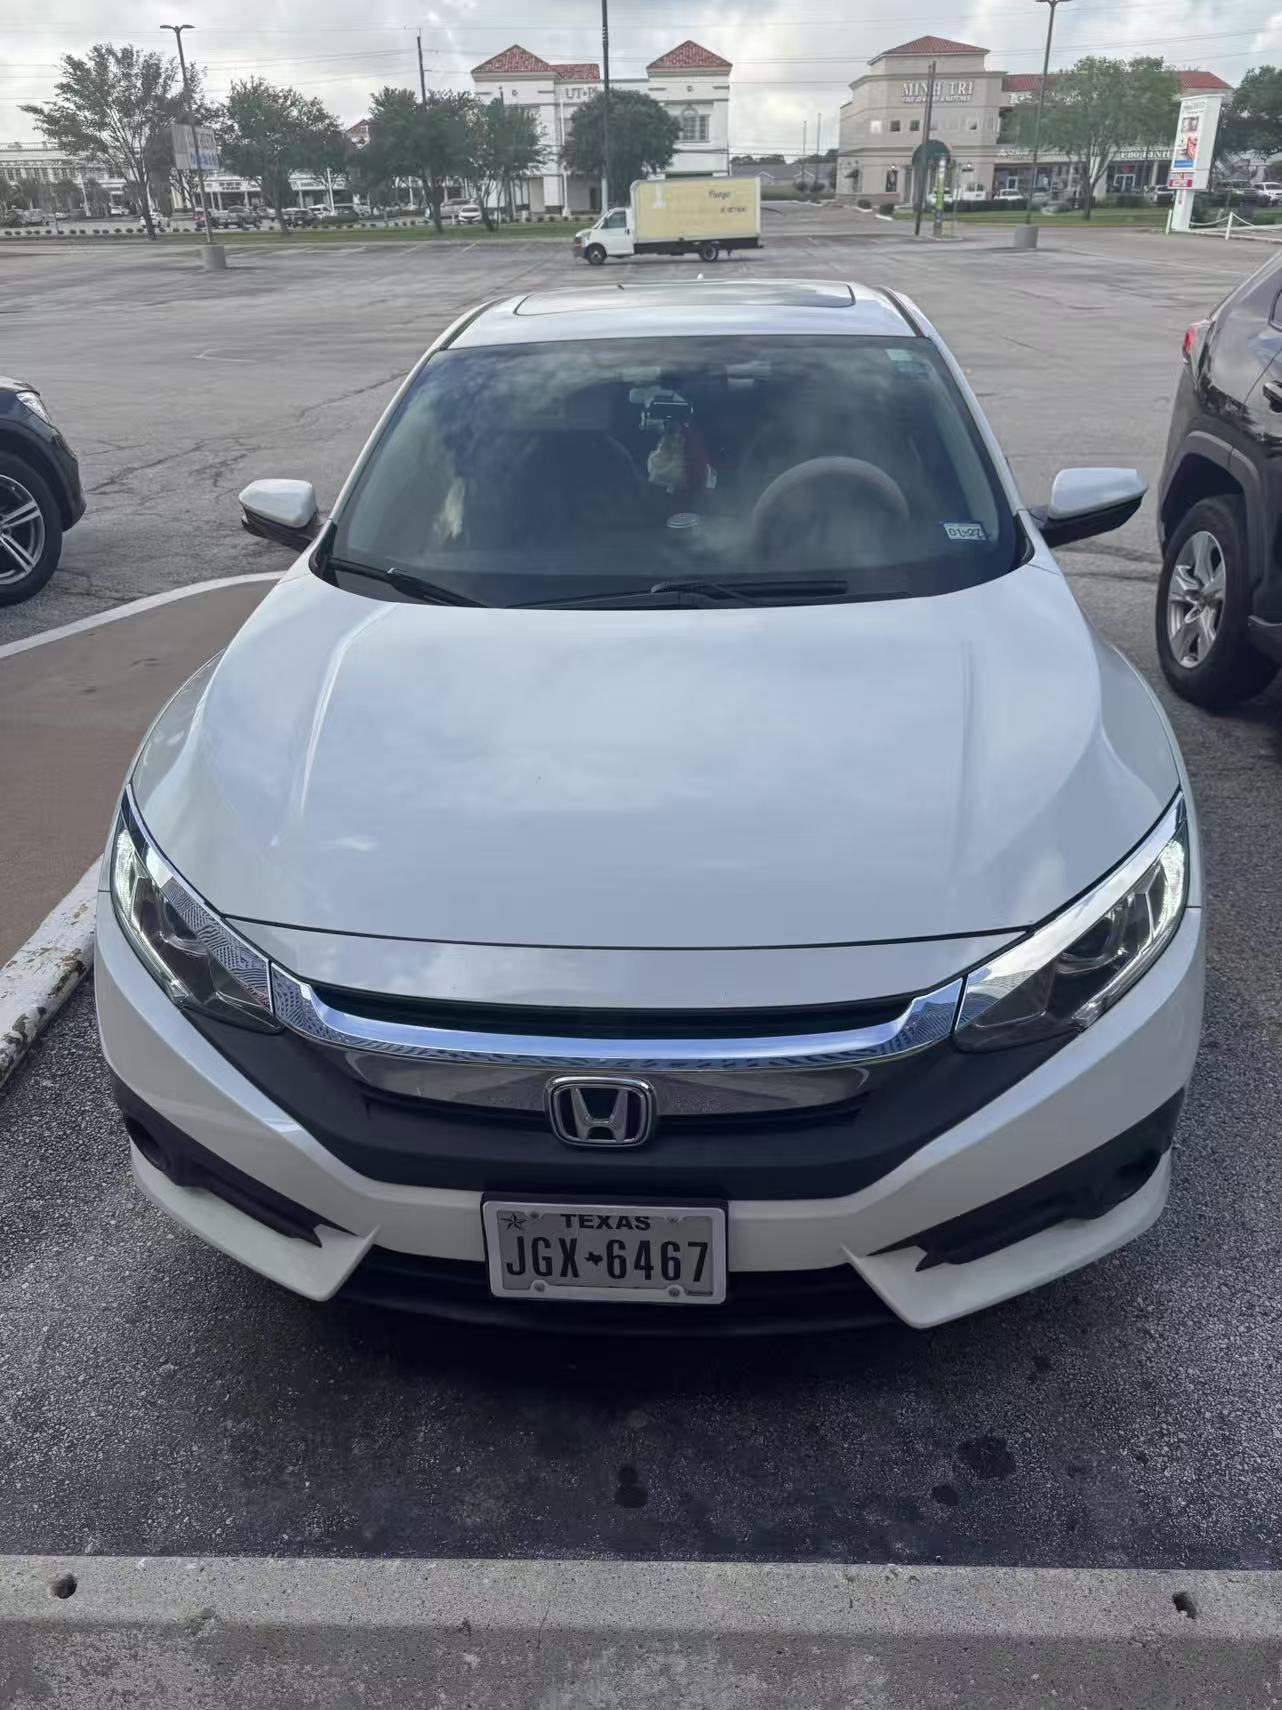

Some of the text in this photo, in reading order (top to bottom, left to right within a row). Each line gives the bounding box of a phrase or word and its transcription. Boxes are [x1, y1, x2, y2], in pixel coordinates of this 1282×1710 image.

[903, 81, 975, 96] MINH TRI
[560, 1213, 651, 1231] TEXAS
[506, 1235, 709, 1283] JGX 6467
